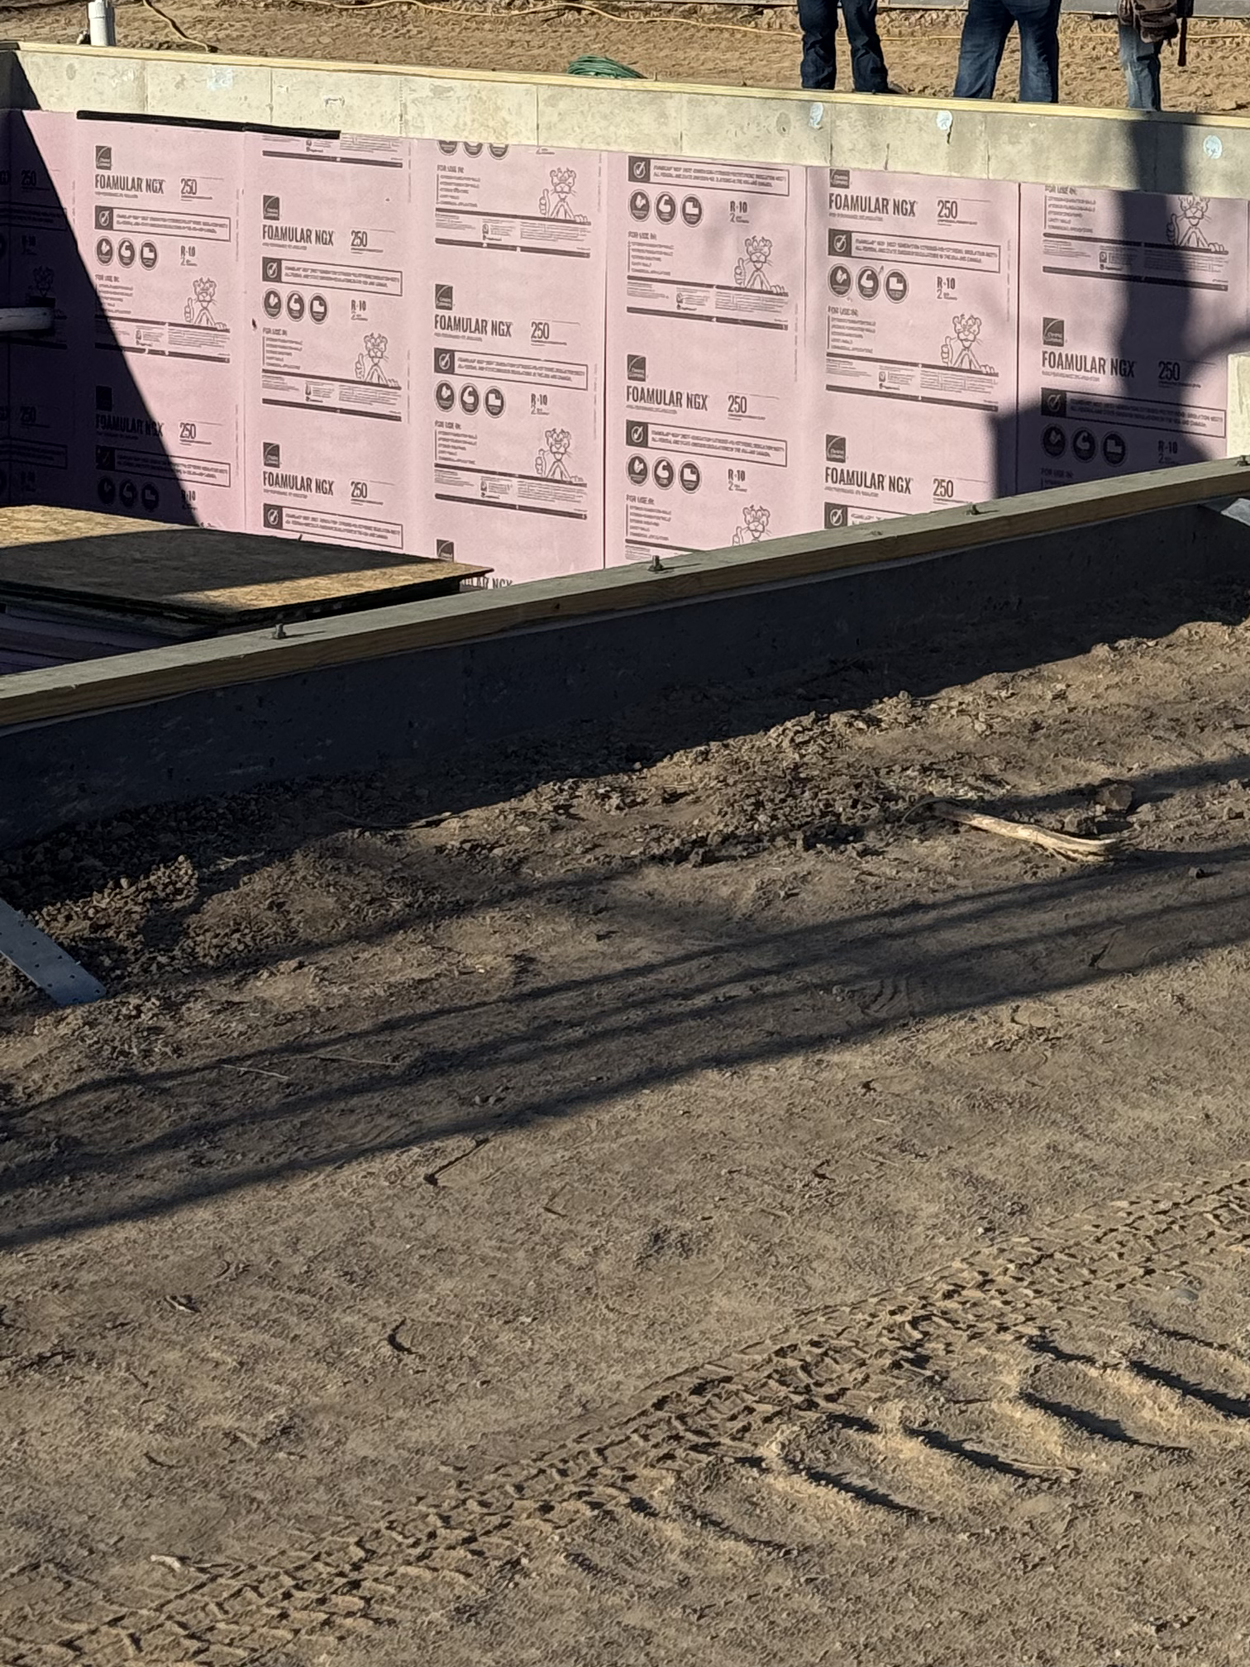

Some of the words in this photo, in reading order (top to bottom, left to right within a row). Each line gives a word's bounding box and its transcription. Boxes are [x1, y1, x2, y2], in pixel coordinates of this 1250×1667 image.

[95, 174, 143, 193] FOAMULAR
[146, 179, 164, 194] NGX
[181, 179, 197, 195] 250
[730, 201, 748, 213] R-10
[829, 193, 889, 216] FOAMULAR
[893, 200, 916, 217] NGX
[937, 200, 958, 219] 250
[262, 224, 312, 244] FOAMULAR
[315, 229, 334, 246] NGX
[351, 230, 368, 247] 250
[937, 276, 956, 290] R-10
[434, 314, 487, 334] FOAMULAR
[491, 321, 512, 338] NGX
[531, 322, 550, 340] 250
[1042, 350, 1106, 375] FOAMULAR
[1110, 358, 1135, 378] NGX
[1158, 361, 1180, 381] 250
[626, 385, 682, 408] FOAMULAR
[686, 392, 708, 411] NGX
[728, 395, 747, 414] 250
[179, 422, 196, 439] 250
[263, 471, 312, 493] FOAMULAR
[315, 478, 334, 496] NGX
[351, 481, 368, 499] 250
[825, 466, 884, 491] FOAMULAR
[889, 475, 911, 495] NGX
[933, 478, 954, 498] 250
